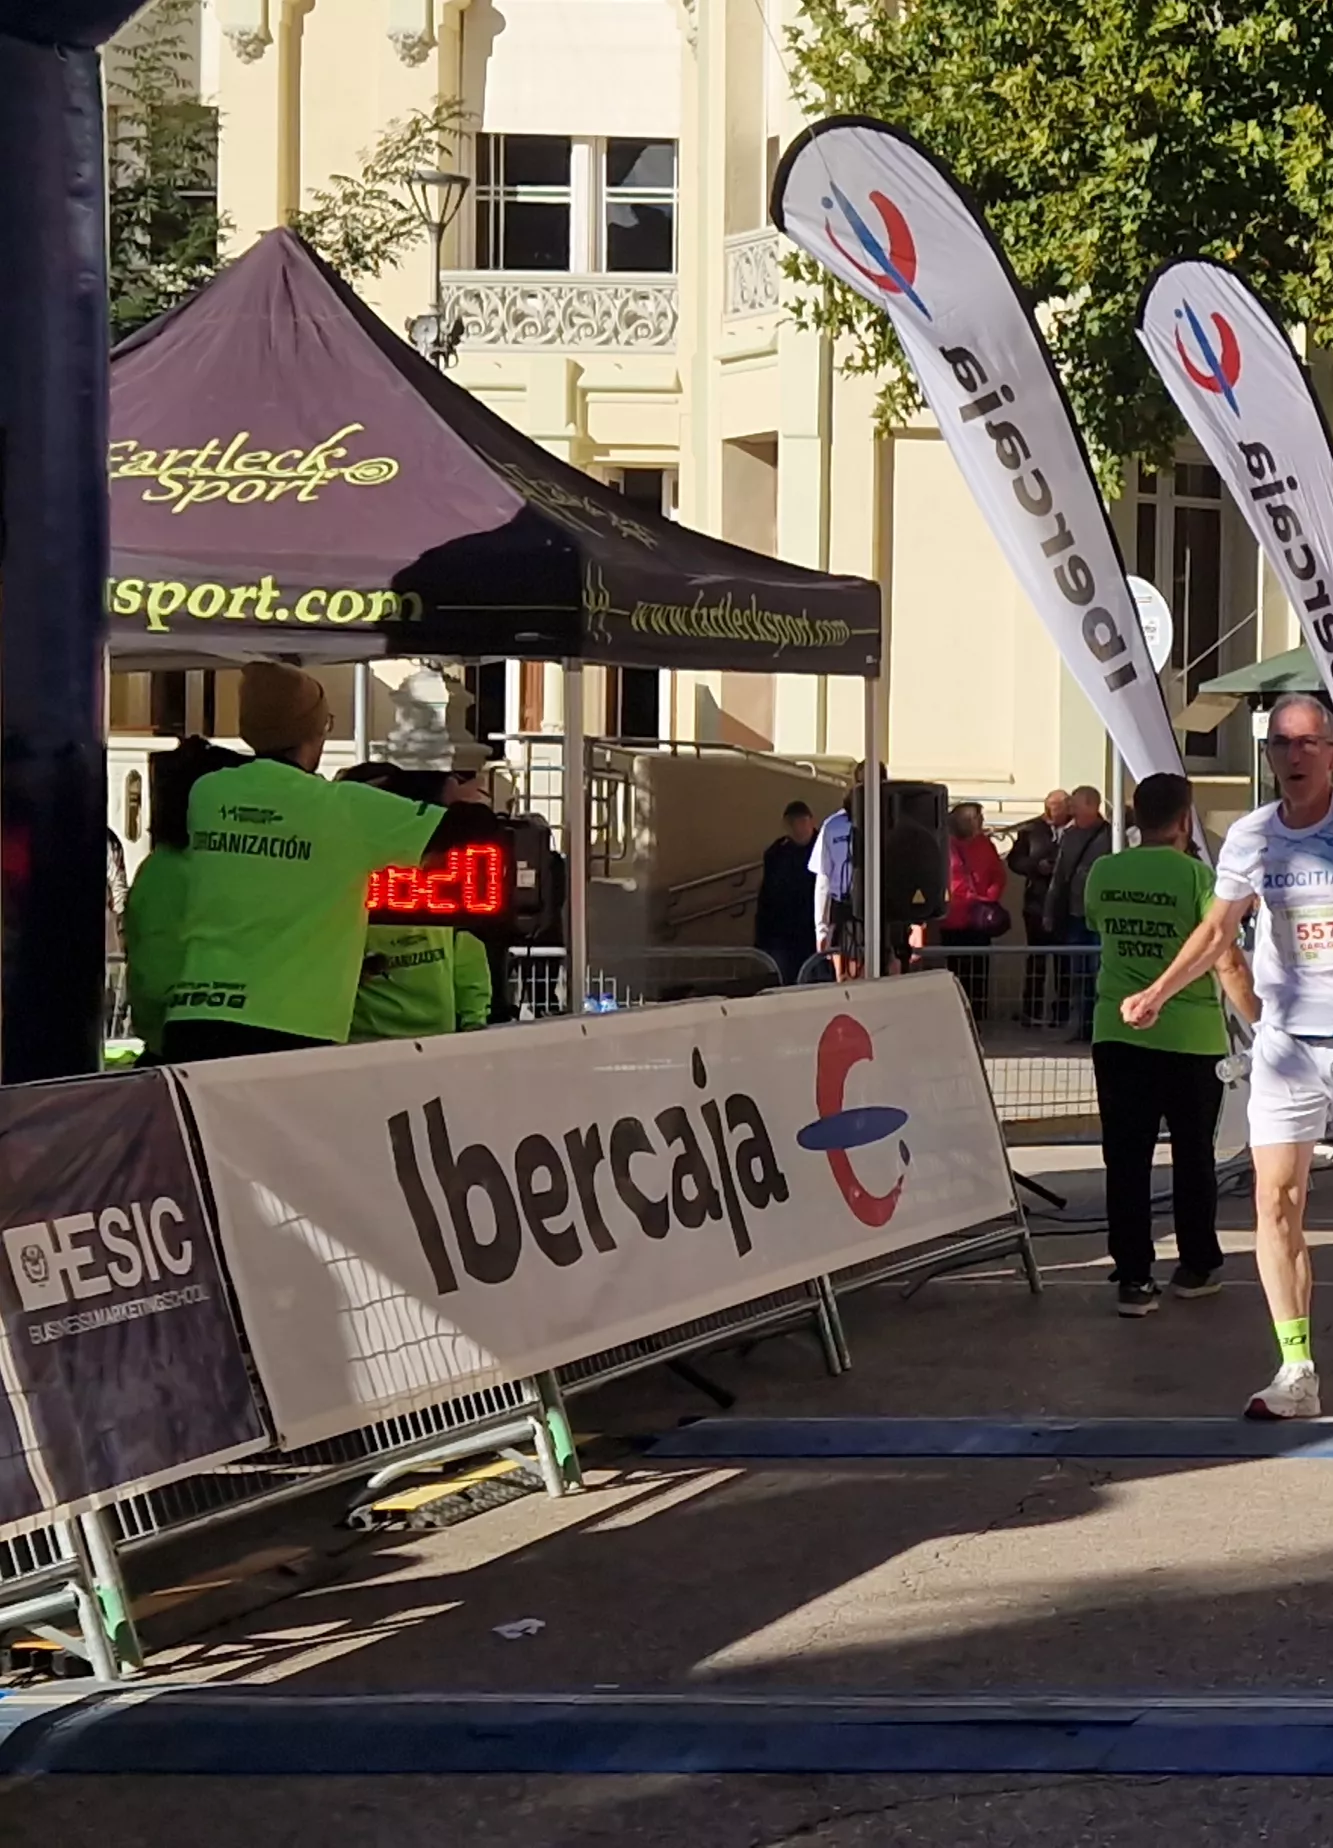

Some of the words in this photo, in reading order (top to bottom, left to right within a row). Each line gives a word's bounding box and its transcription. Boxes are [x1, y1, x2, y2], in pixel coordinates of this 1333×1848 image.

[142, 468, 327, 514] Sport
[387, 1046, 790, 1296] Ibercaja
[53, 1196, 193, 1300] ESIC
